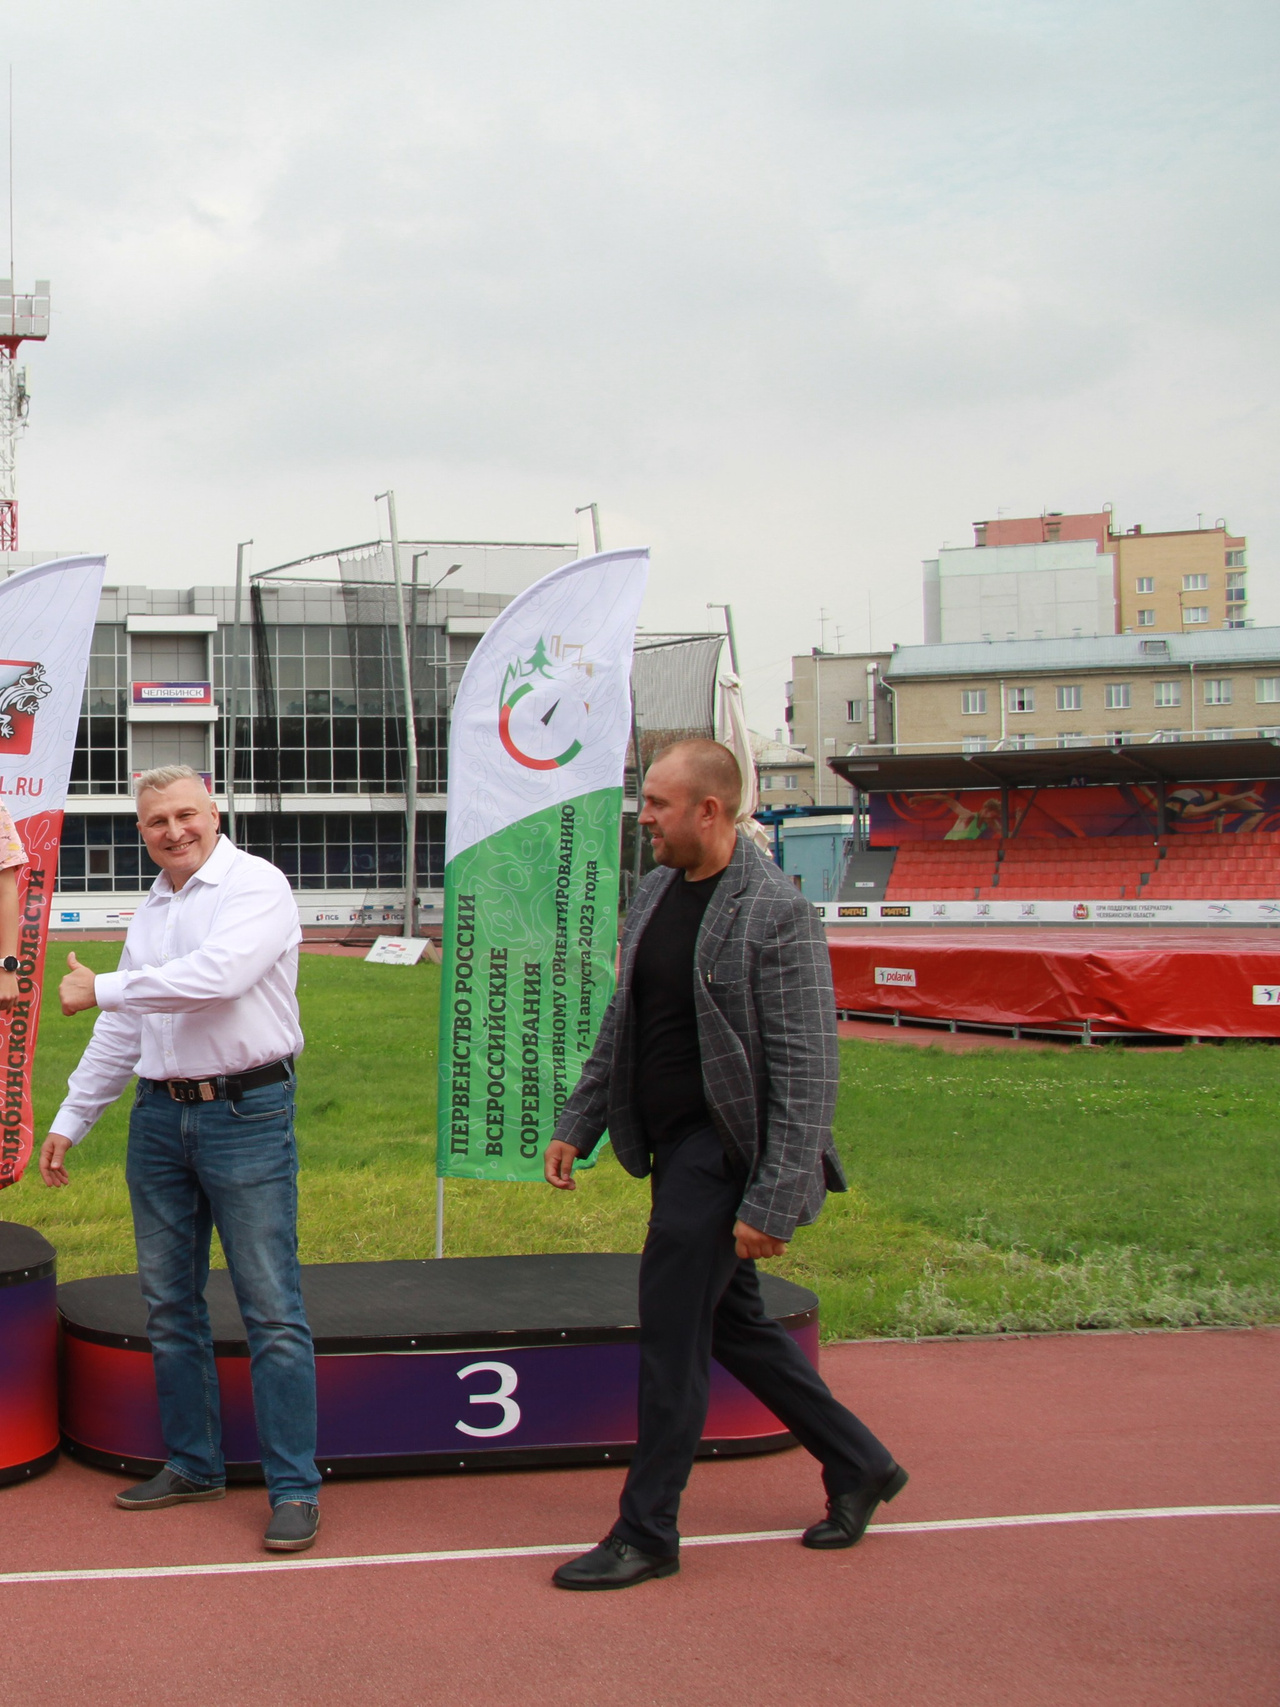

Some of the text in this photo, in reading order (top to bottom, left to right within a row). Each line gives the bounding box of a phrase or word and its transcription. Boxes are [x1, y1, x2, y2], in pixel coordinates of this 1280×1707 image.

[143, 689, 202, 697] ЧЕЛЯБИНСК
[17, 869, 45, 993] области
[552, 804, 575, 987] ОРИЕНТИРОВАНИЮ
[577, 860, 600, 1052] 7-11 августа 2023 года
[886, 971, 913, 983] polanik
[451, 894, 475, 1155] ПЕРВЕНСТВО РОССИИ
[482, 948, 508, 1157] ВСЕРОССИЙСКИЕ
[520, 962, 541, 1158] СОРЕВНОВАНИЯ
[455, 1361, 521, 1437] 3
